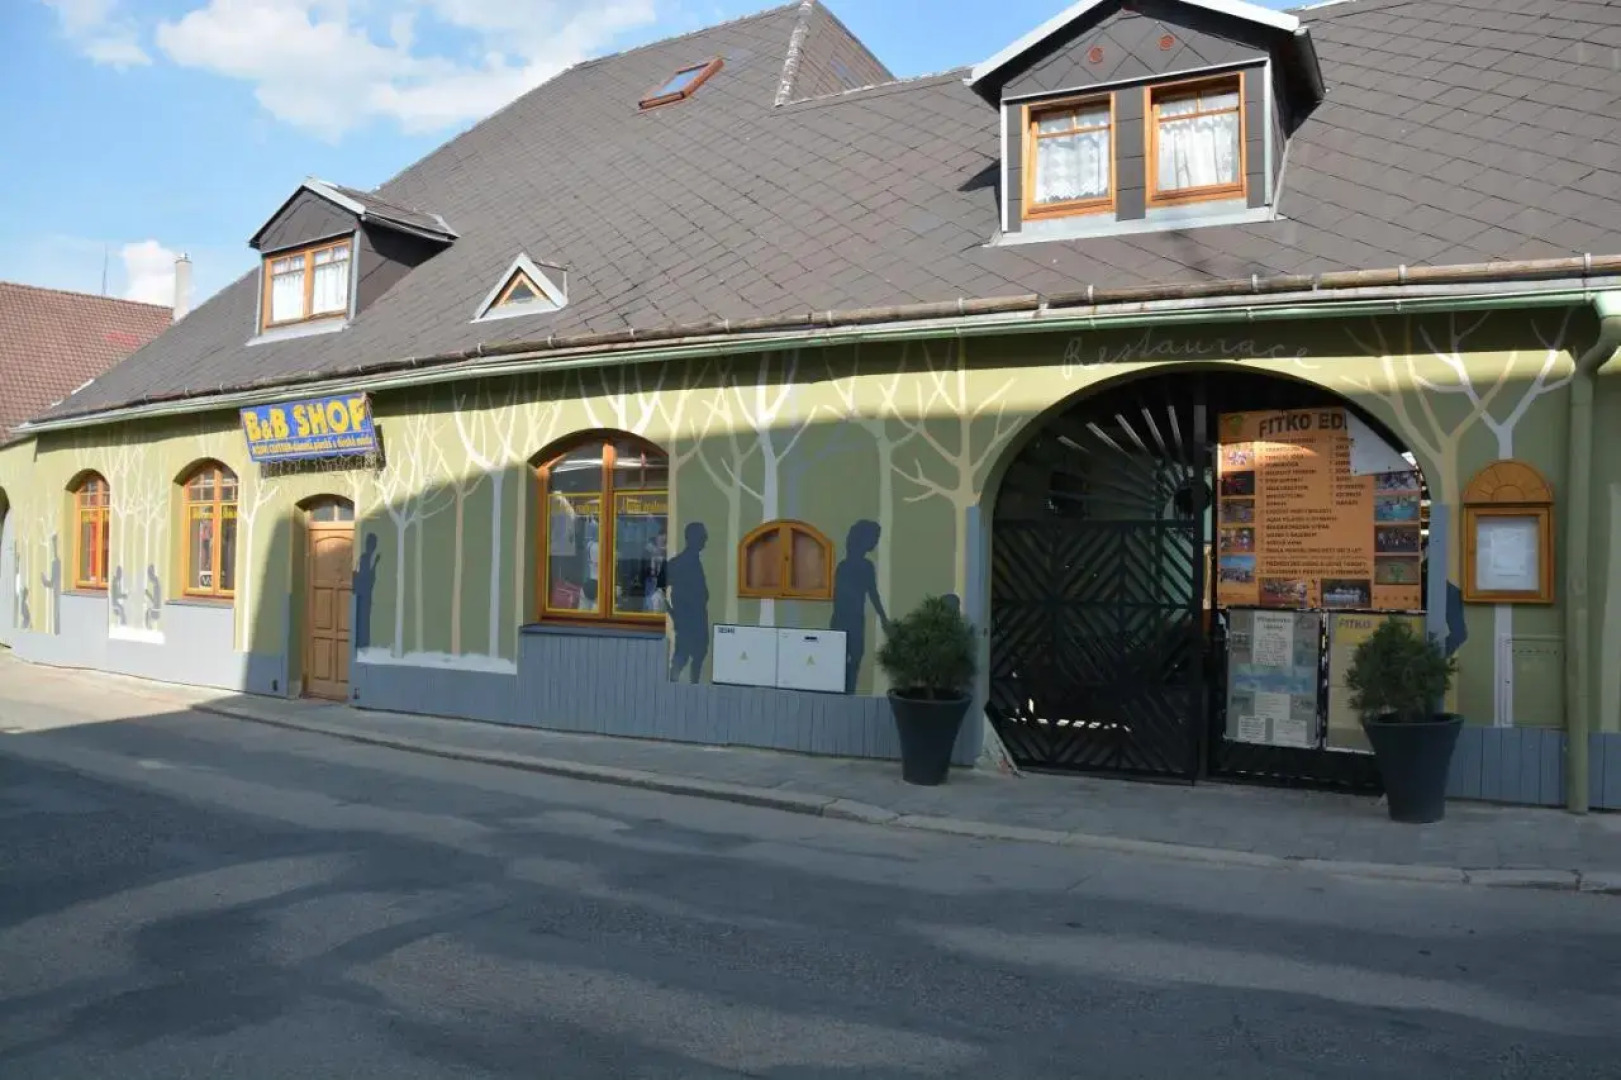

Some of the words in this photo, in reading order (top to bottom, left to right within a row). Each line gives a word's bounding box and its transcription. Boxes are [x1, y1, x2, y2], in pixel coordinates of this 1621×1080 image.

[1062, 329, 1322, 380] Restaurace
[243, 408, 289, 441] B&B
[293, 398, 366, 437] SHOP
[1258, 412, 1312, 438] FITKO
